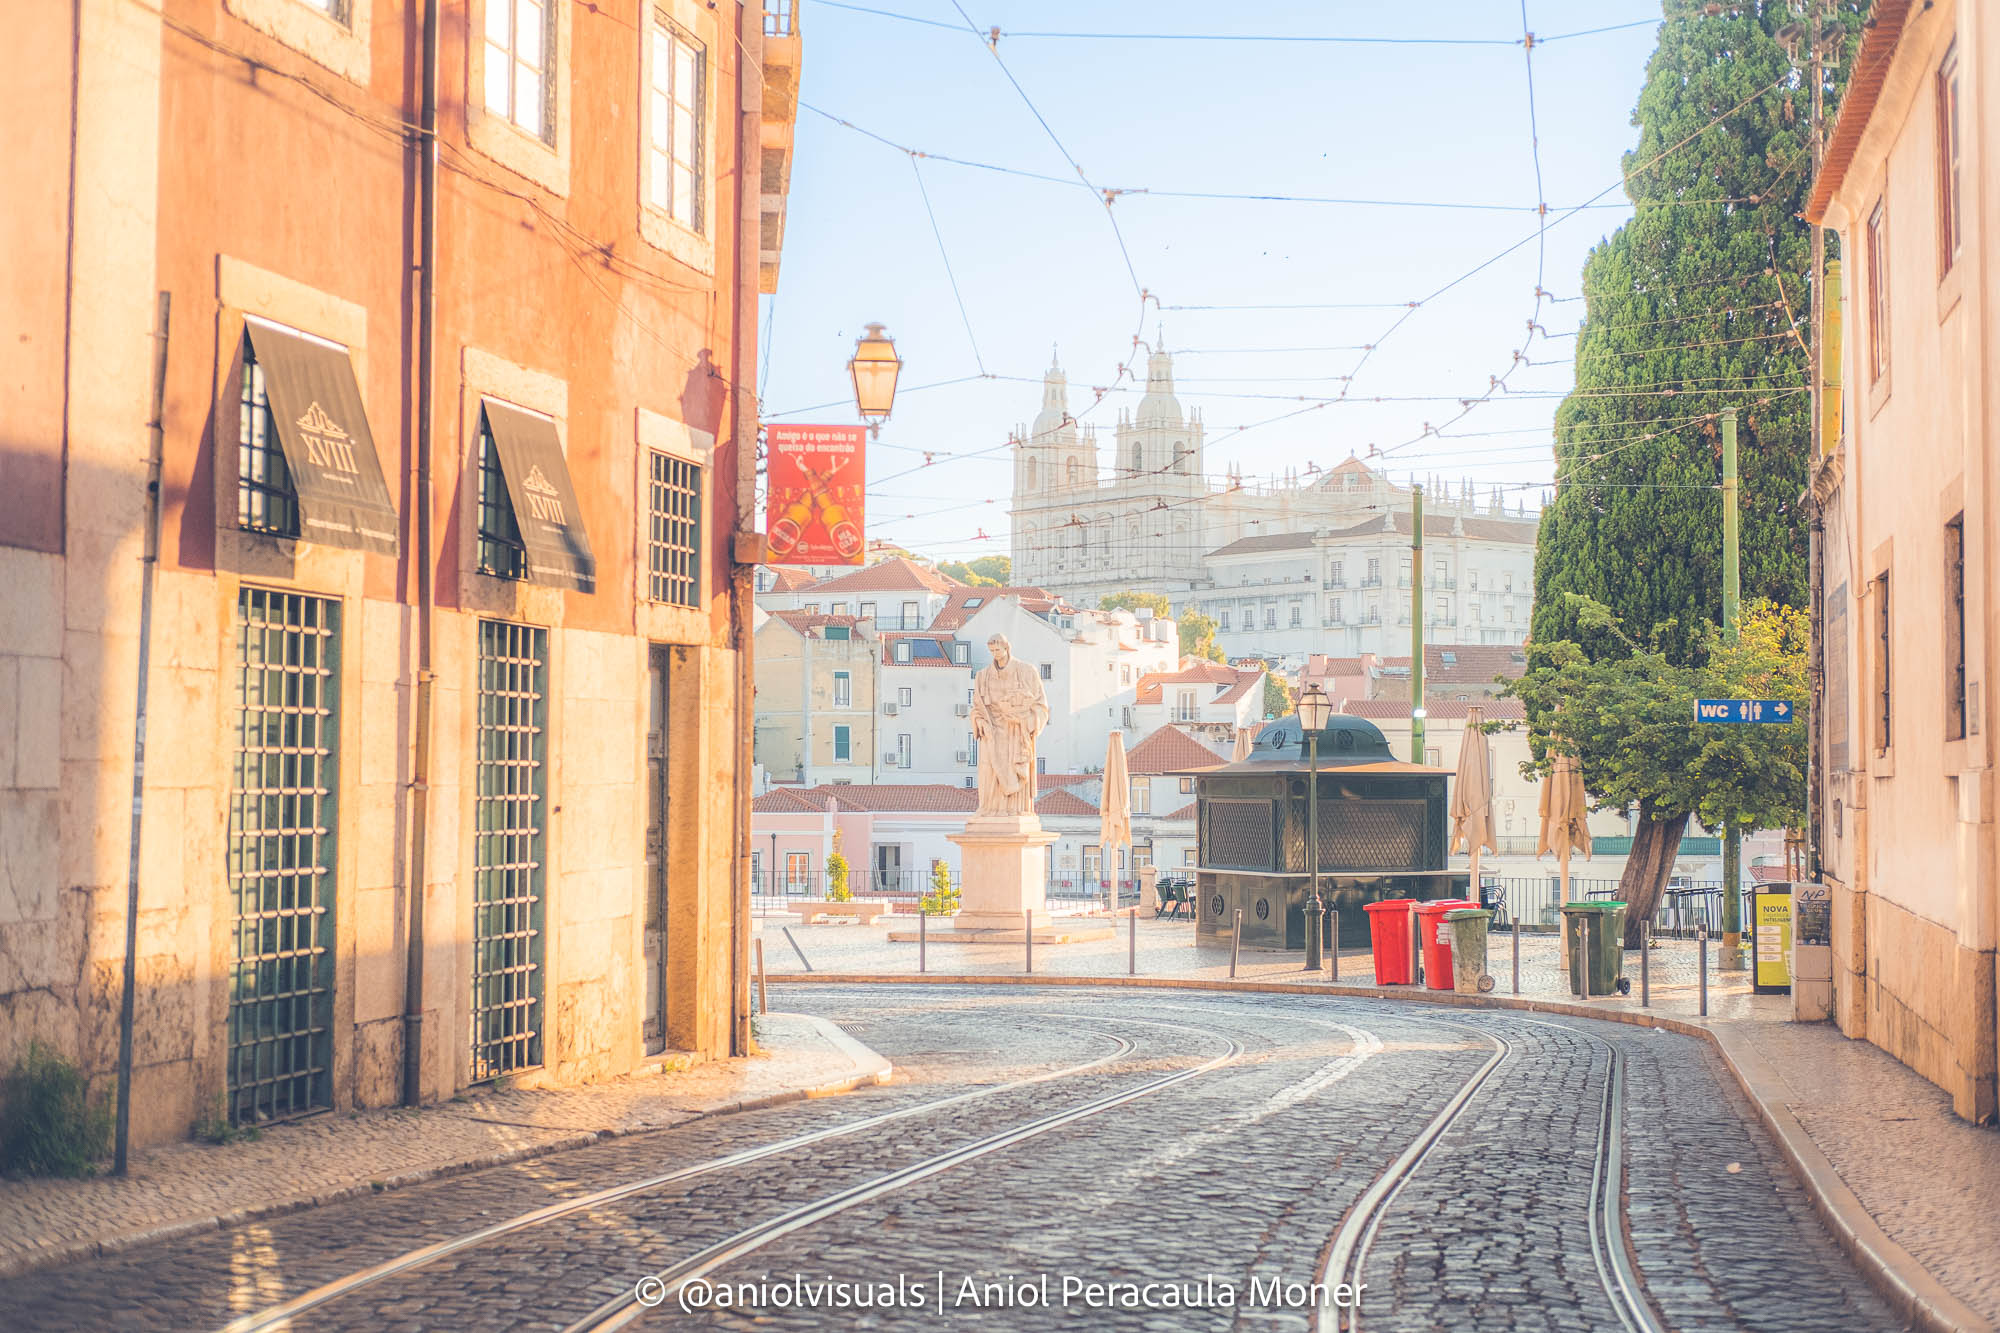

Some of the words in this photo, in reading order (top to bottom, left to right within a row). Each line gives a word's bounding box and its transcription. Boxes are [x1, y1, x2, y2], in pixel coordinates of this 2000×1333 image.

[777, 431, 801, 445] Amigo
[815, 432, 831, 444] que
[831, 431, 847, 442] não
[847, 432, 857, 442] se
[300, 433, 360, 474] XVIII
[526, 492, 567, 526] XVIII
[1700, 704, 1729, 717] WC
